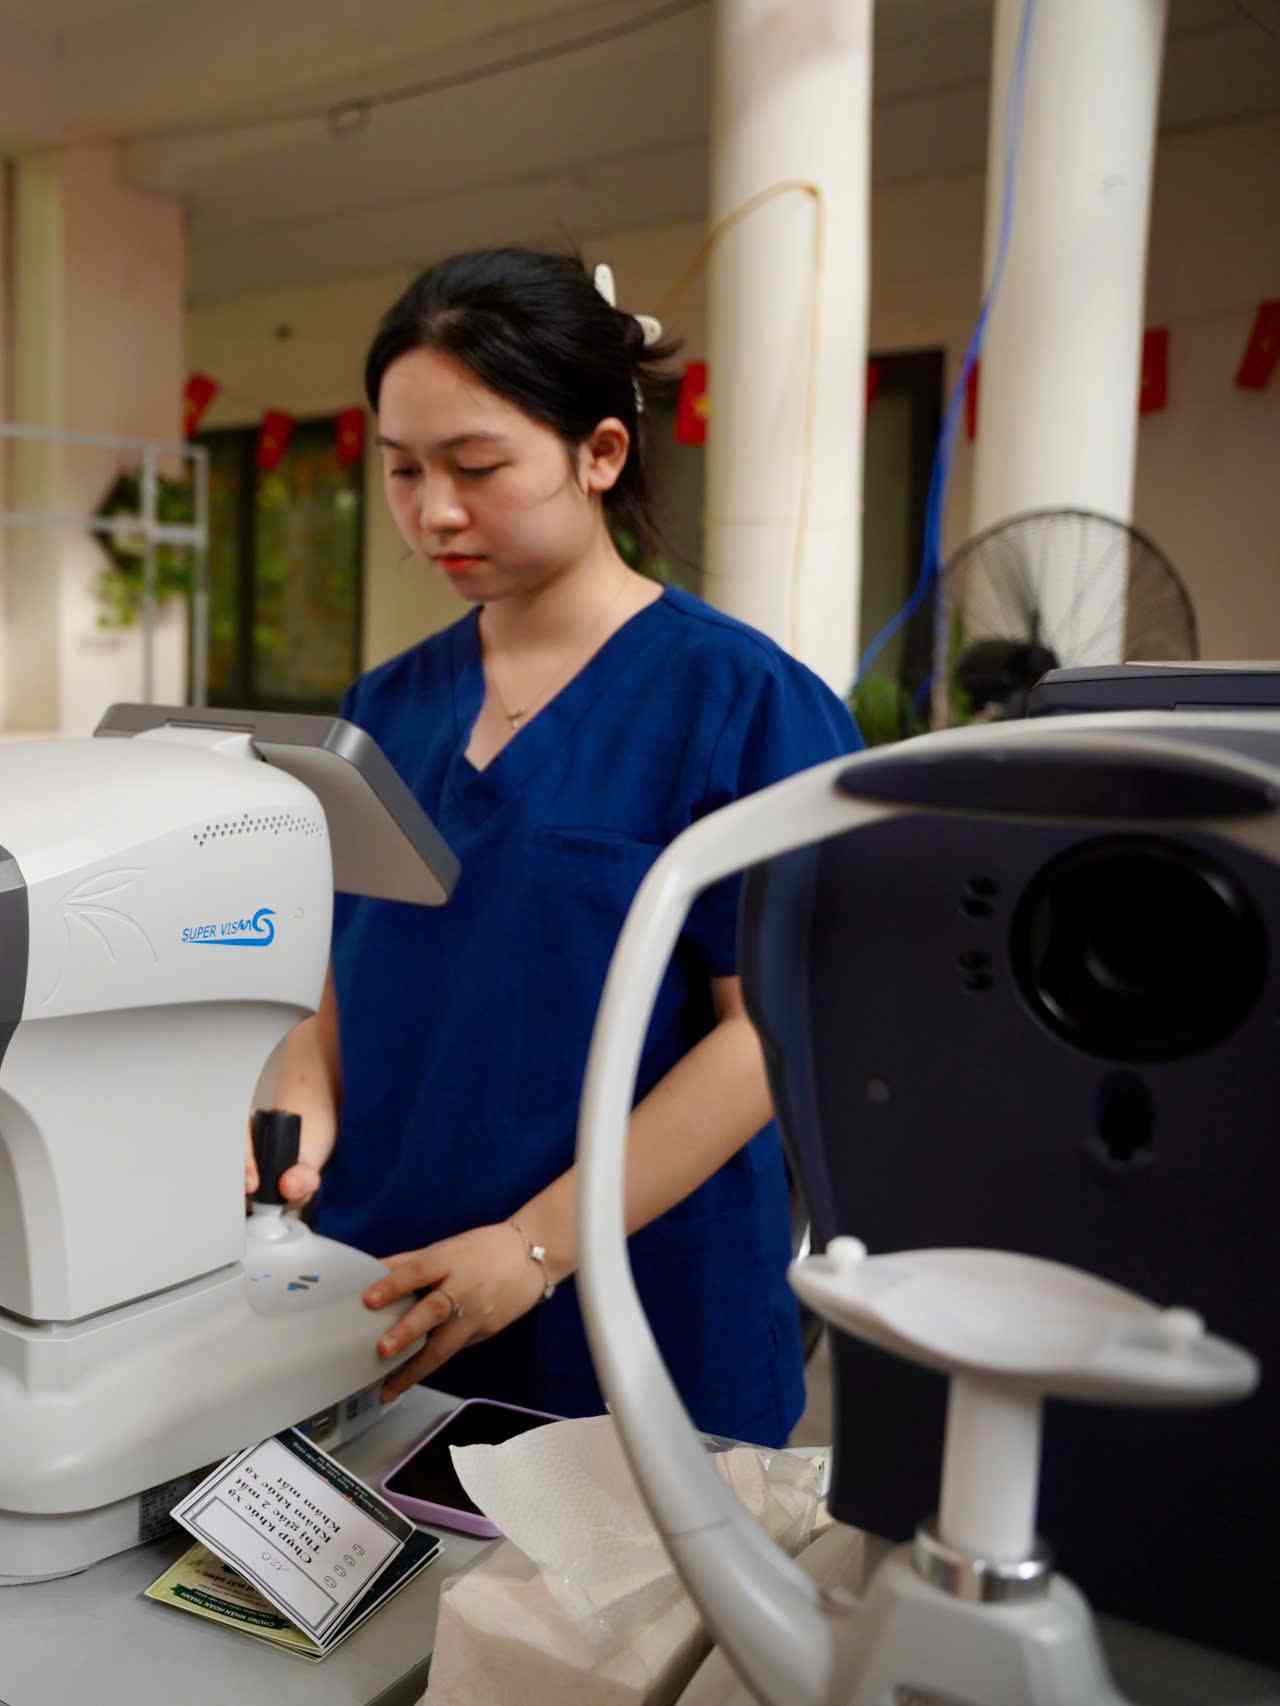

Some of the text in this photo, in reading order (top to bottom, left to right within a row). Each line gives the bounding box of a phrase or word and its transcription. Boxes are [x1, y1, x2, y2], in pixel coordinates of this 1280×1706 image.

[182, 925, 216, 941] SUPER
[246, 1504, 276, 1533] khúc
[293, 1508, 331, 1544] Khám
[304, 1498, 341, 1533] Khám
[278, 1531, 312, 1564] Chụp
